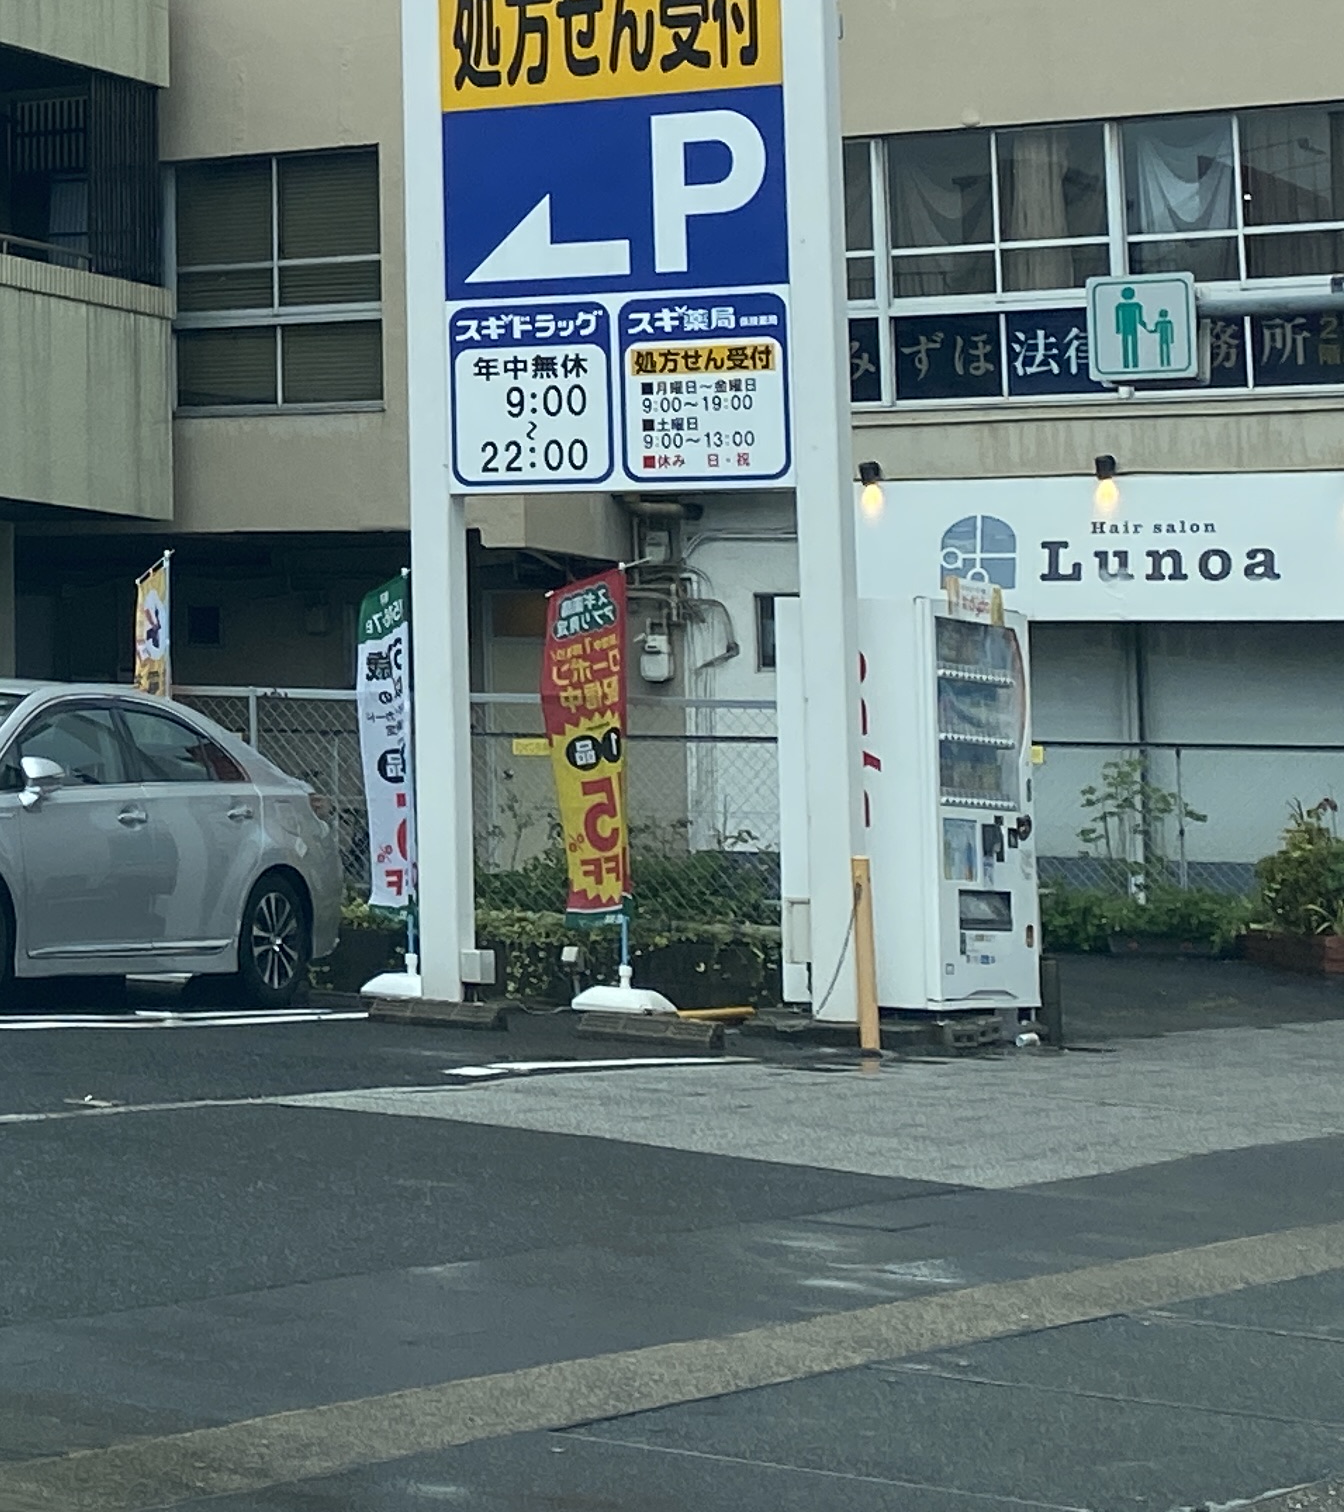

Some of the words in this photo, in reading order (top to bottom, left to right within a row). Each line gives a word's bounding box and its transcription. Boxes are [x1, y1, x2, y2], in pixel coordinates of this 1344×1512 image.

[649, 108, 767, 273] P
[455, 310, 604, 341] スギドラッグ
[627, 305, 736, 334] スギ薬局
[473, 353, 588, 382] 年中無休
[634, 345, 772, 375] 処方せん受付
[506, 384, 587, 418] 9:00
[656, 417, 699, 432] 土曜日
[480, 438, 588, 473] 22:00
[1091, 521, 1143, 535] Hair
[1153, 520, 1217, 534] salon
[1039, 540, 1281, 582] Lunoa
